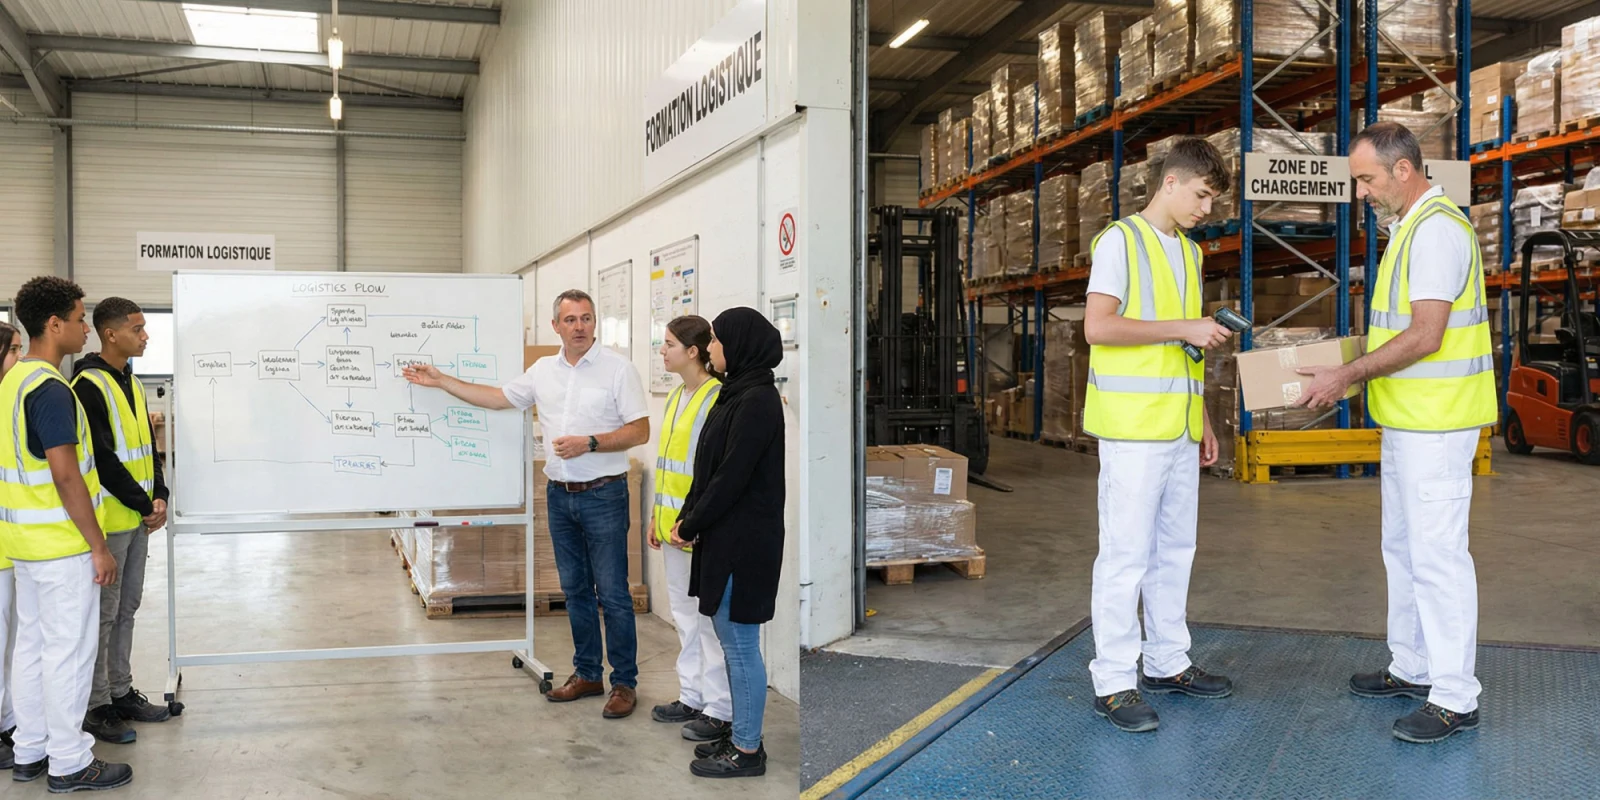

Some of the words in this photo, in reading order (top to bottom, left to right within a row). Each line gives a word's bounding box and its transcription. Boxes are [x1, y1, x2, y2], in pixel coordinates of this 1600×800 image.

[646, 85, 693, 157] FORMATION
[695, 30, 762, 123] LOGISTIQUE
[1268, 158, 1306, 175] ZONE
[1310, 160, 1328, 175] DE
[1251, 178, 1346, 197] CHARGEMENT
[140, 244, 204, 259] FORMATION
[207, 246, 271, 261] LOGISTIQUE
